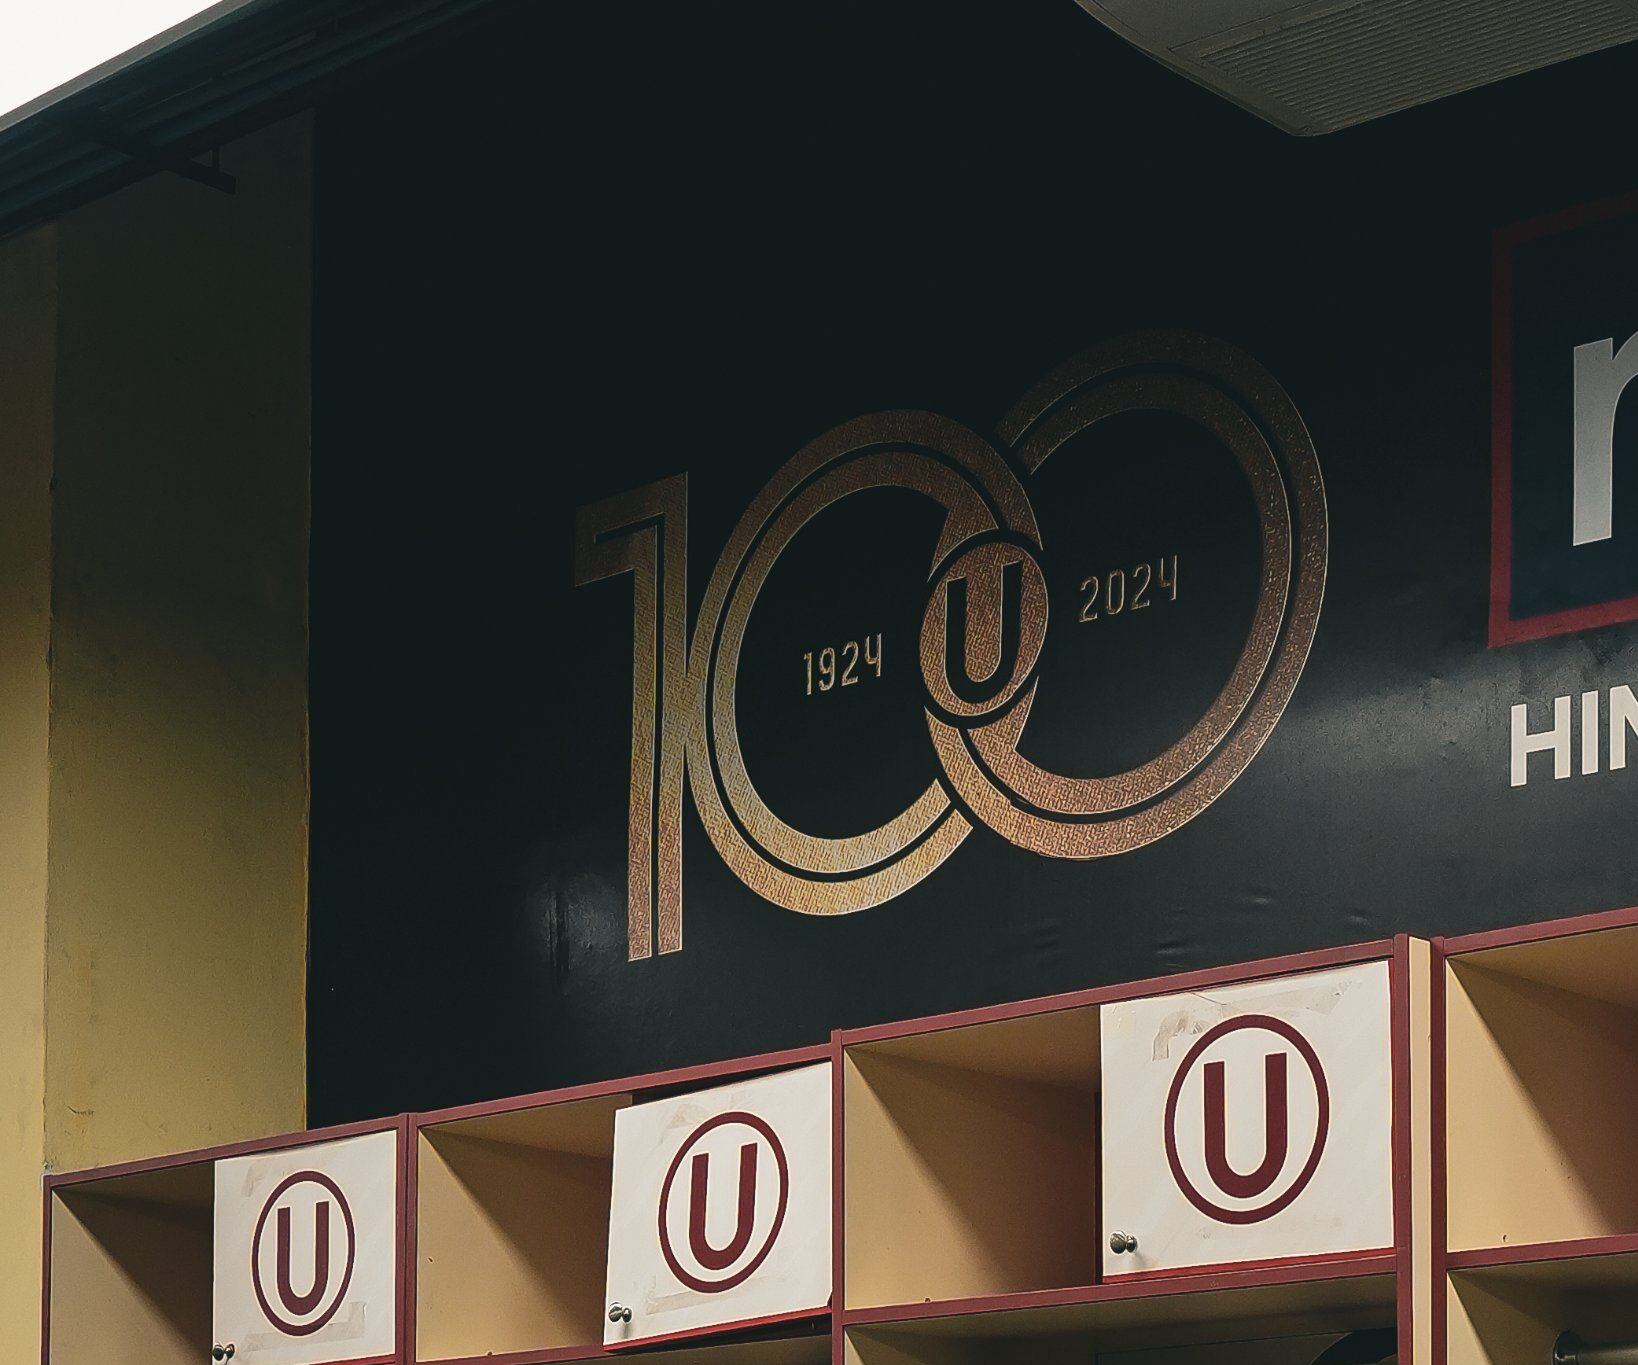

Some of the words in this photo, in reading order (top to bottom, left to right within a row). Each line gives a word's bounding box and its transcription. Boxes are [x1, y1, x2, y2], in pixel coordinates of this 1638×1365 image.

[1079, 554, 1178, 624] 2024
[803, 633, 882, 696] 1924
[1203, 1052, 1289, 1200] U
[277, 1201, 329, 1315] U
[688, 1143, 757, 1271] U
